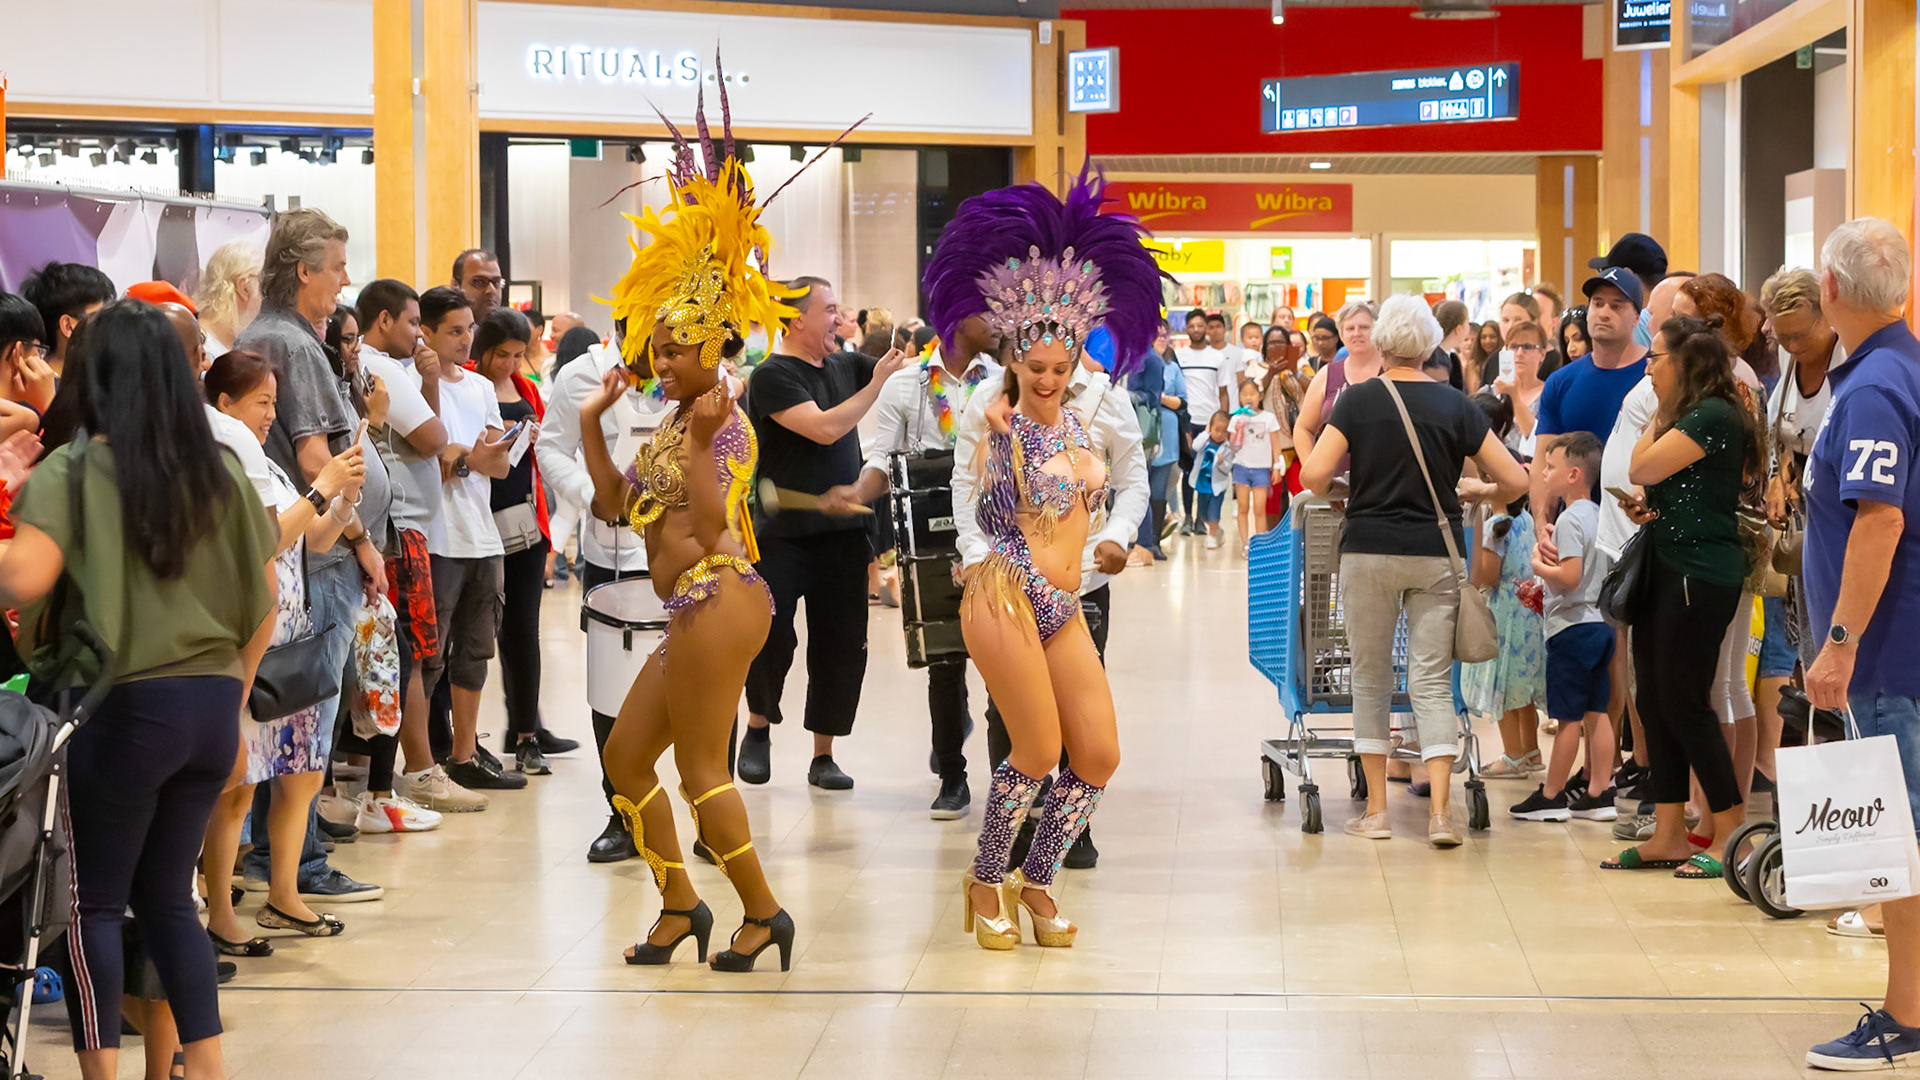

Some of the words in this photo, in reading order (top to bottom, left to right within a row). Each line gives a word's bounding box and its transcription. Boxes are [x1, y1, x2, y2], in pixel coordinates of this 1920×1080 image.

[1622, 1, 1671, 18] Juwelier
[1128, 187, 1207, 211] Wibra
[1255, 187, 1333, 211] Wibra
[1150, 247, 1193, 264] aby
[1846, 439, 1898, 485] 72
[1795, 797, 1885, 835] Meow
